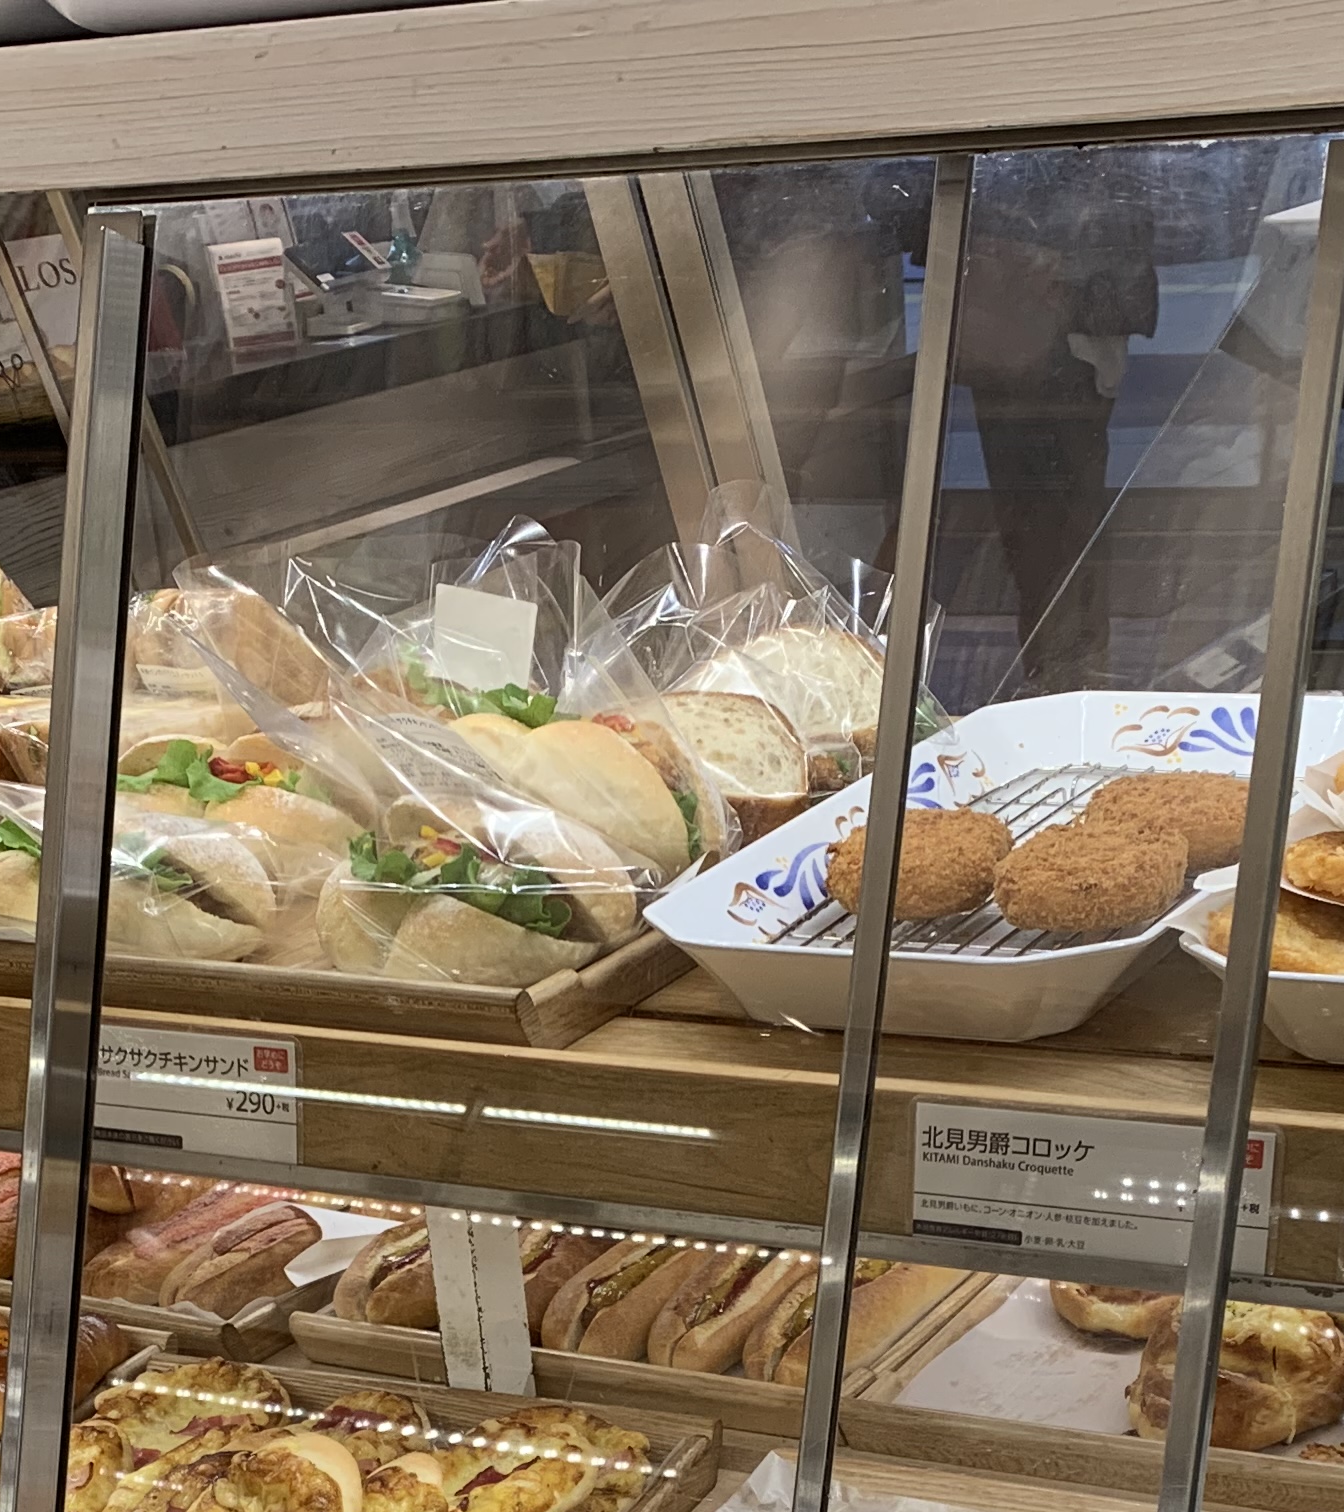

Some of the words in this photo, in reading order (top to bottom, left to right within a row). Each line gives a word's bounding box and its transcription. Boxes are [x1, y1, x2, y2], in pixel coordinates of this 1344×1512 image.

[99, 1045, 249, 1078] サクサクチキンサンド
[921, 1125, 1095, 1163] 北見男爵コロッケ
[922, 1151, 960, 1165] KITAMI
[961, 1155, 1016, 1171] Danshaku
[1017, 1161, 1075, 1177] Croquette
